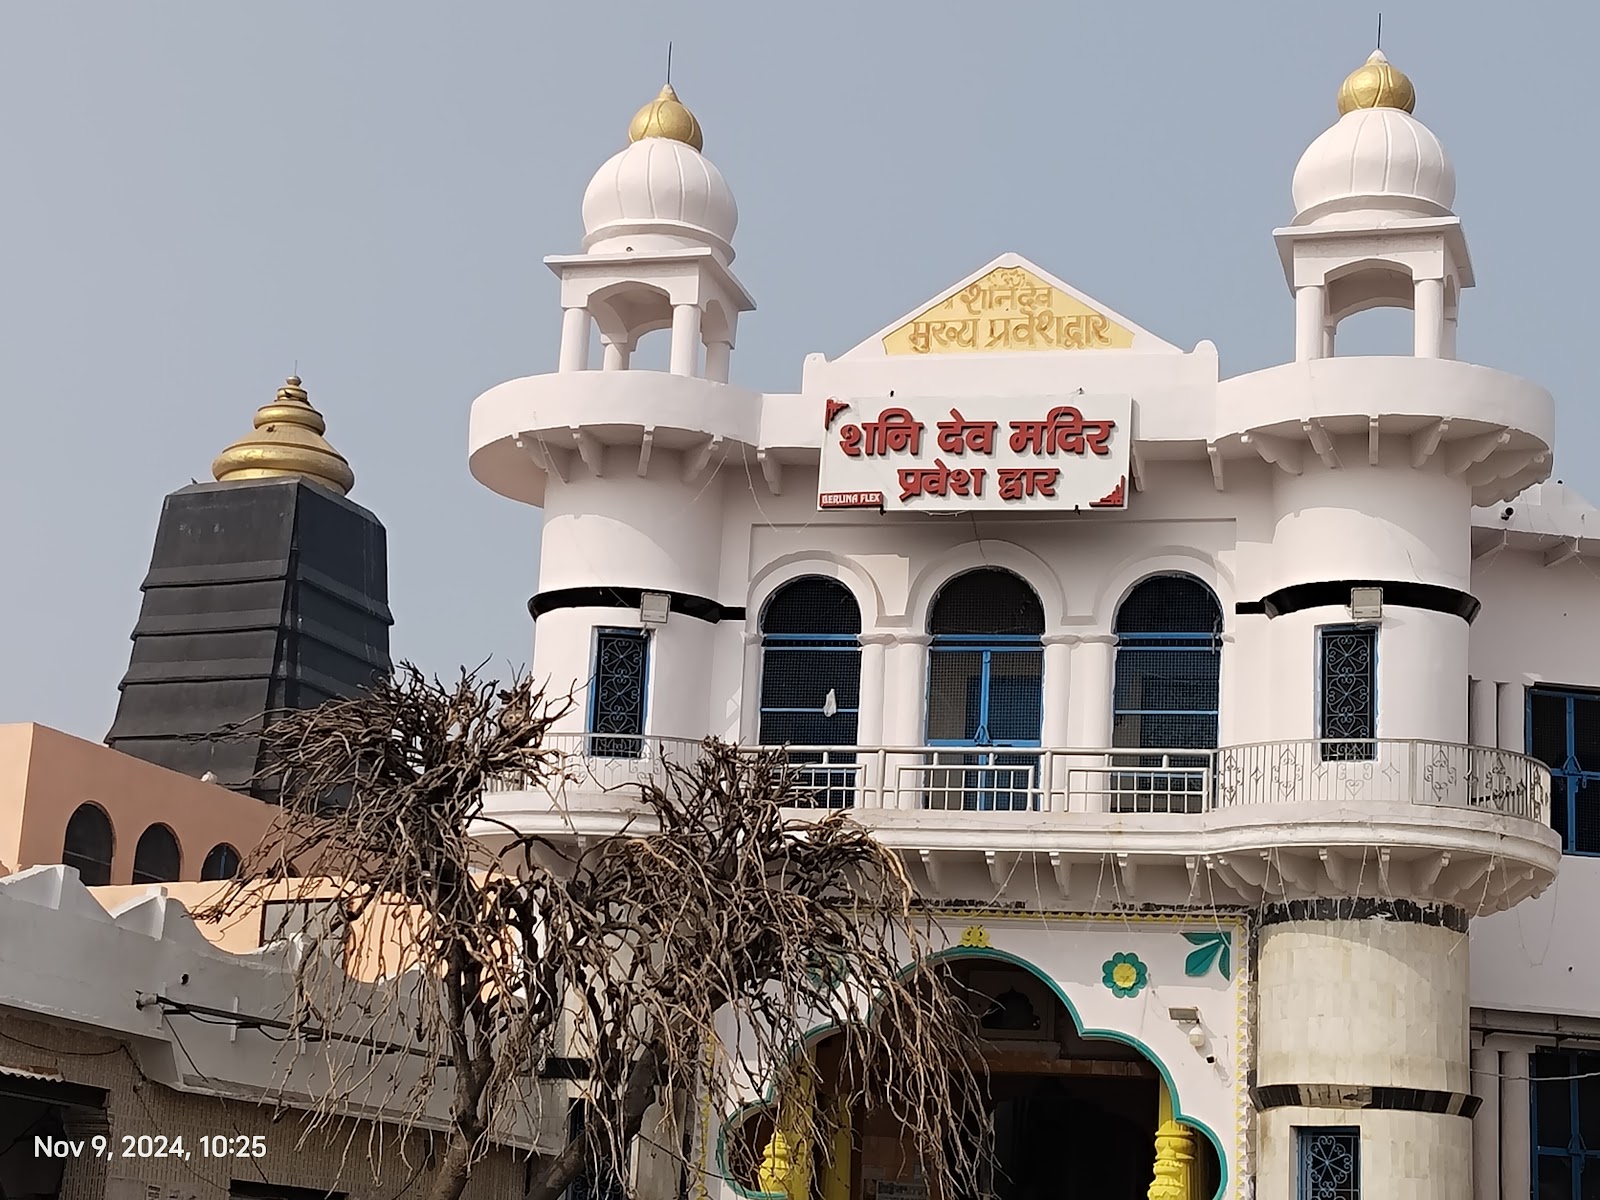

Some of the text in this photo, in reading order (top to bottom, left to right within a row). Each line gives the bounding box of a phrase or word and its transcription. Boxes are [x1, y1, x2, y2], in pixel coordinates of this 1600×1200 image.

[839, 407, 925, 456] शनि
[936, 407, 998, 455] देव
[860, 492, 881, 503] FLEX
[897, 458, 1060, 501] प्रवेश द्वार
